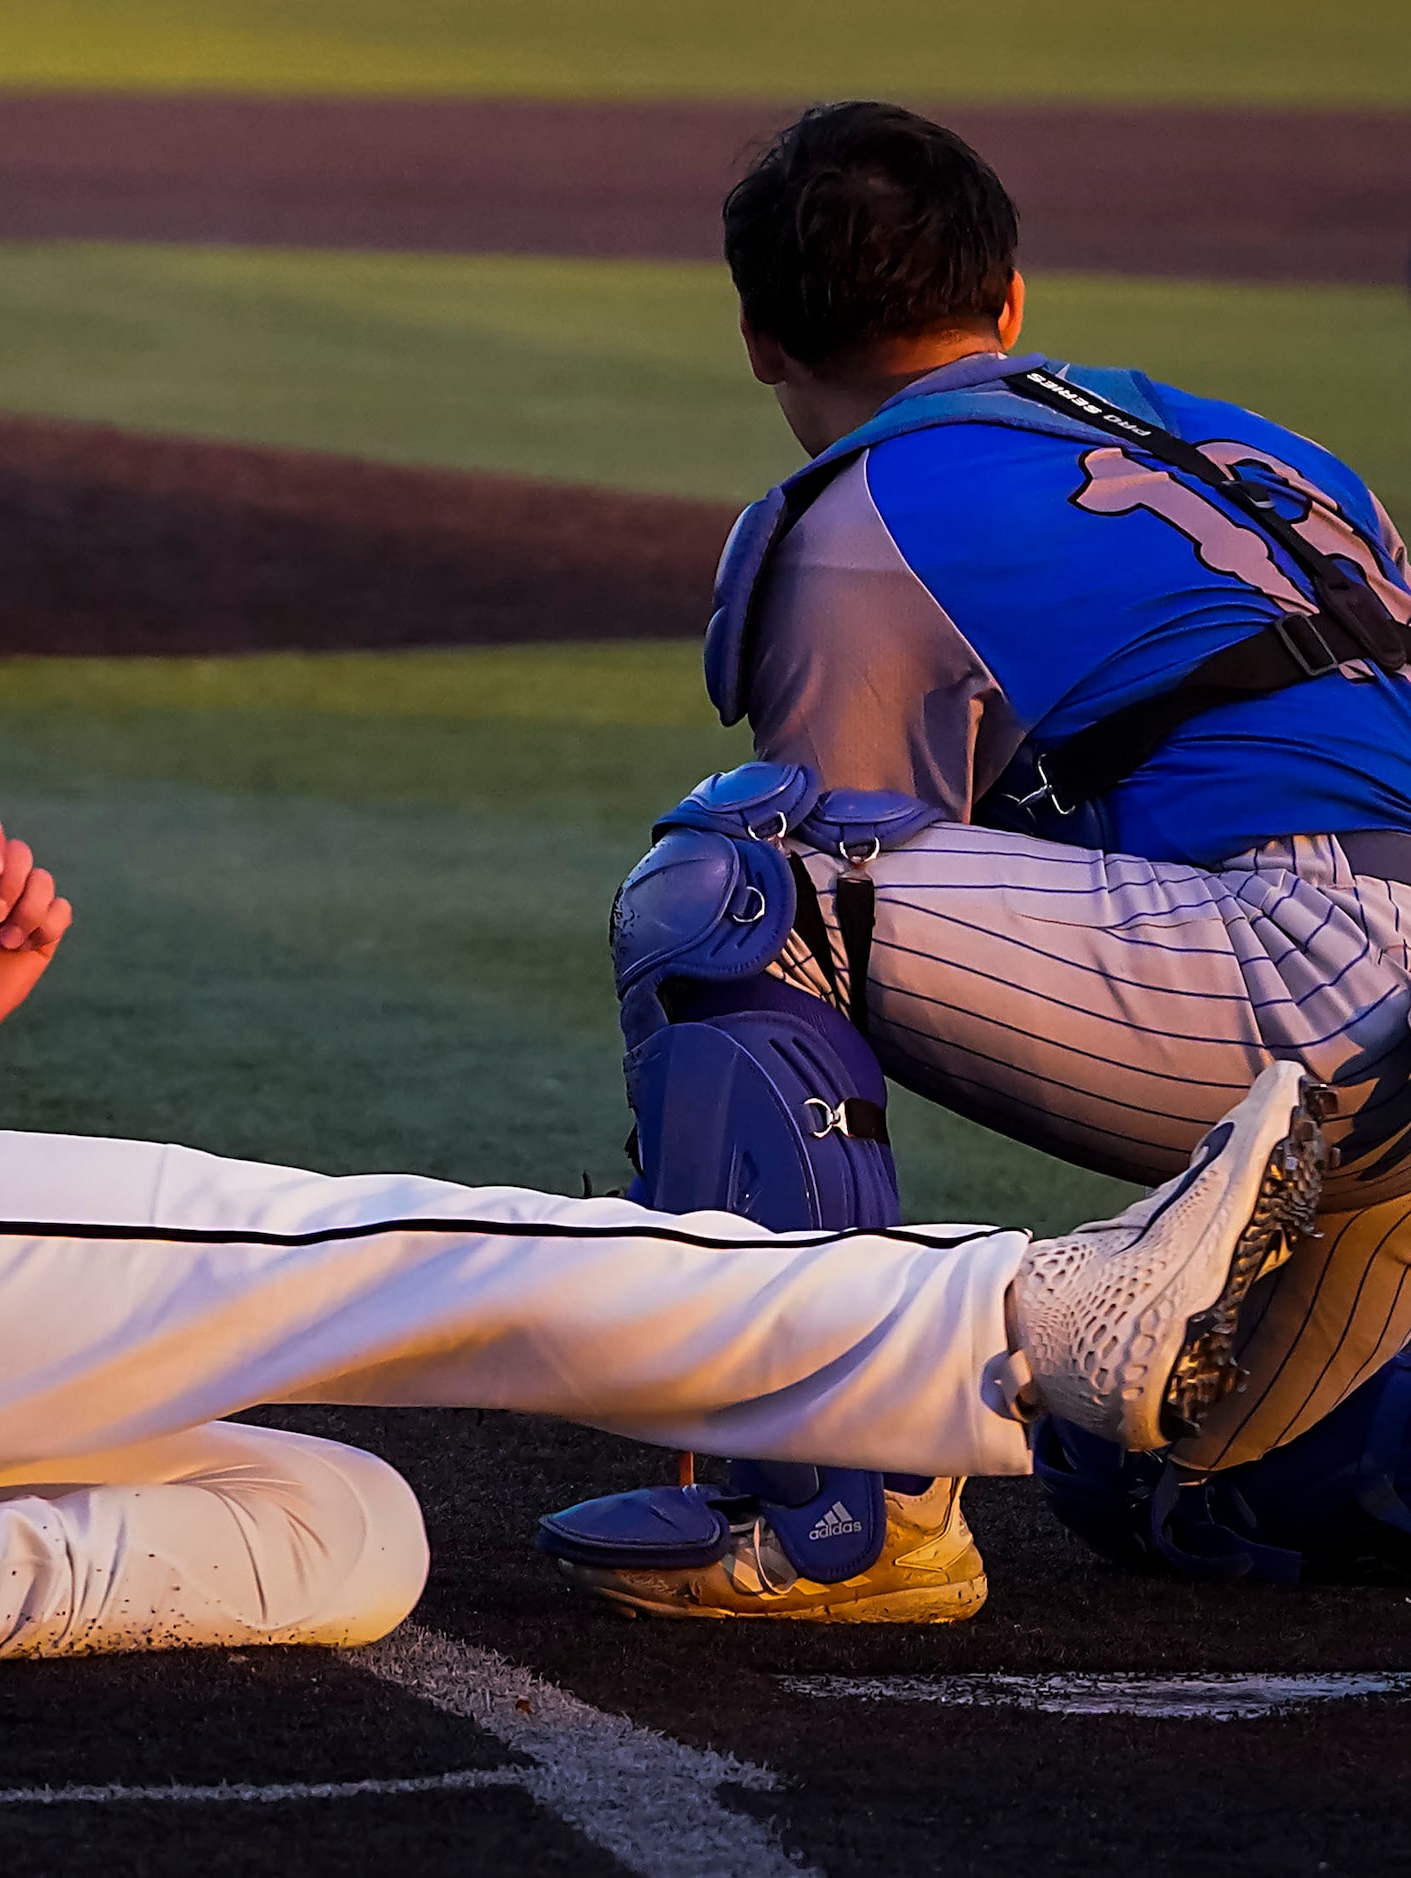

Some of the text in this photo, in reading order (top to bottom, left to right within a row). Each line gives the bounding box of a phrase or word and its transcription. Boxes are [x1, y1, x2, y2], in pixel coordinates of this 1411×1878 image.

[1026, 372, 1152, 436] PRO SERIES
[809, 1522, 862, 1540] adidas
